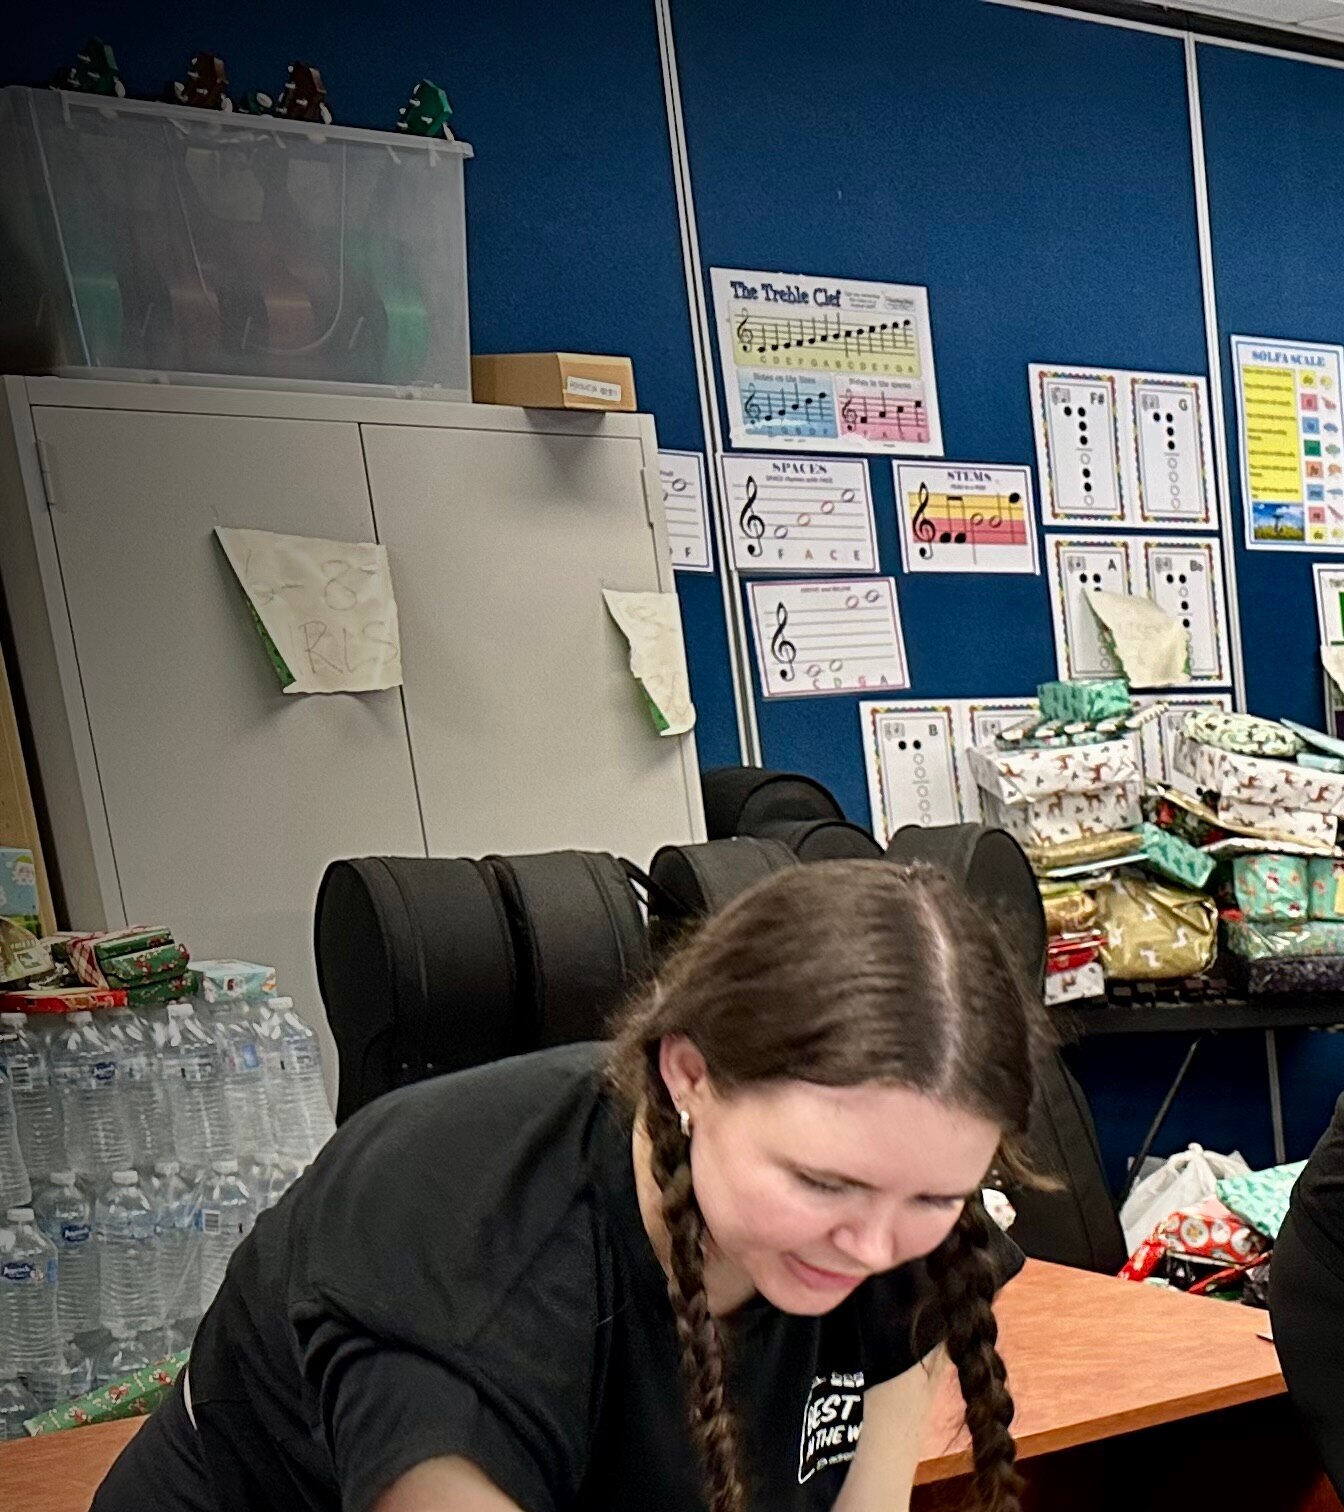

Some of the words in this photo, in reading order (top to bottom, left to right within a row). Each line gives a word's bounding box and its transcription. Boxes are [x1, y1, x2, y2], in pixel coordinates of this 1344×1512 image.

[730, 280, 758, 300] The
[761, 283, 809, 304] Treble
[813, 288, 841, 307] Clef
[772, 462, 828, 475] SPACES
[947, 471, 992, 481] STEMS
[778, 549, 784, 559] F
[804, 549, 813, 560] A
[830, 550, 837, 560] C
[854, 550, 861, 560] E
[1107, 558, 1118, 571] A
[812, 678, 821, 690] C
[834, 677, 842, 689] D
[879, 675, 888, 686] A
[928, 724, 938, 736] B
